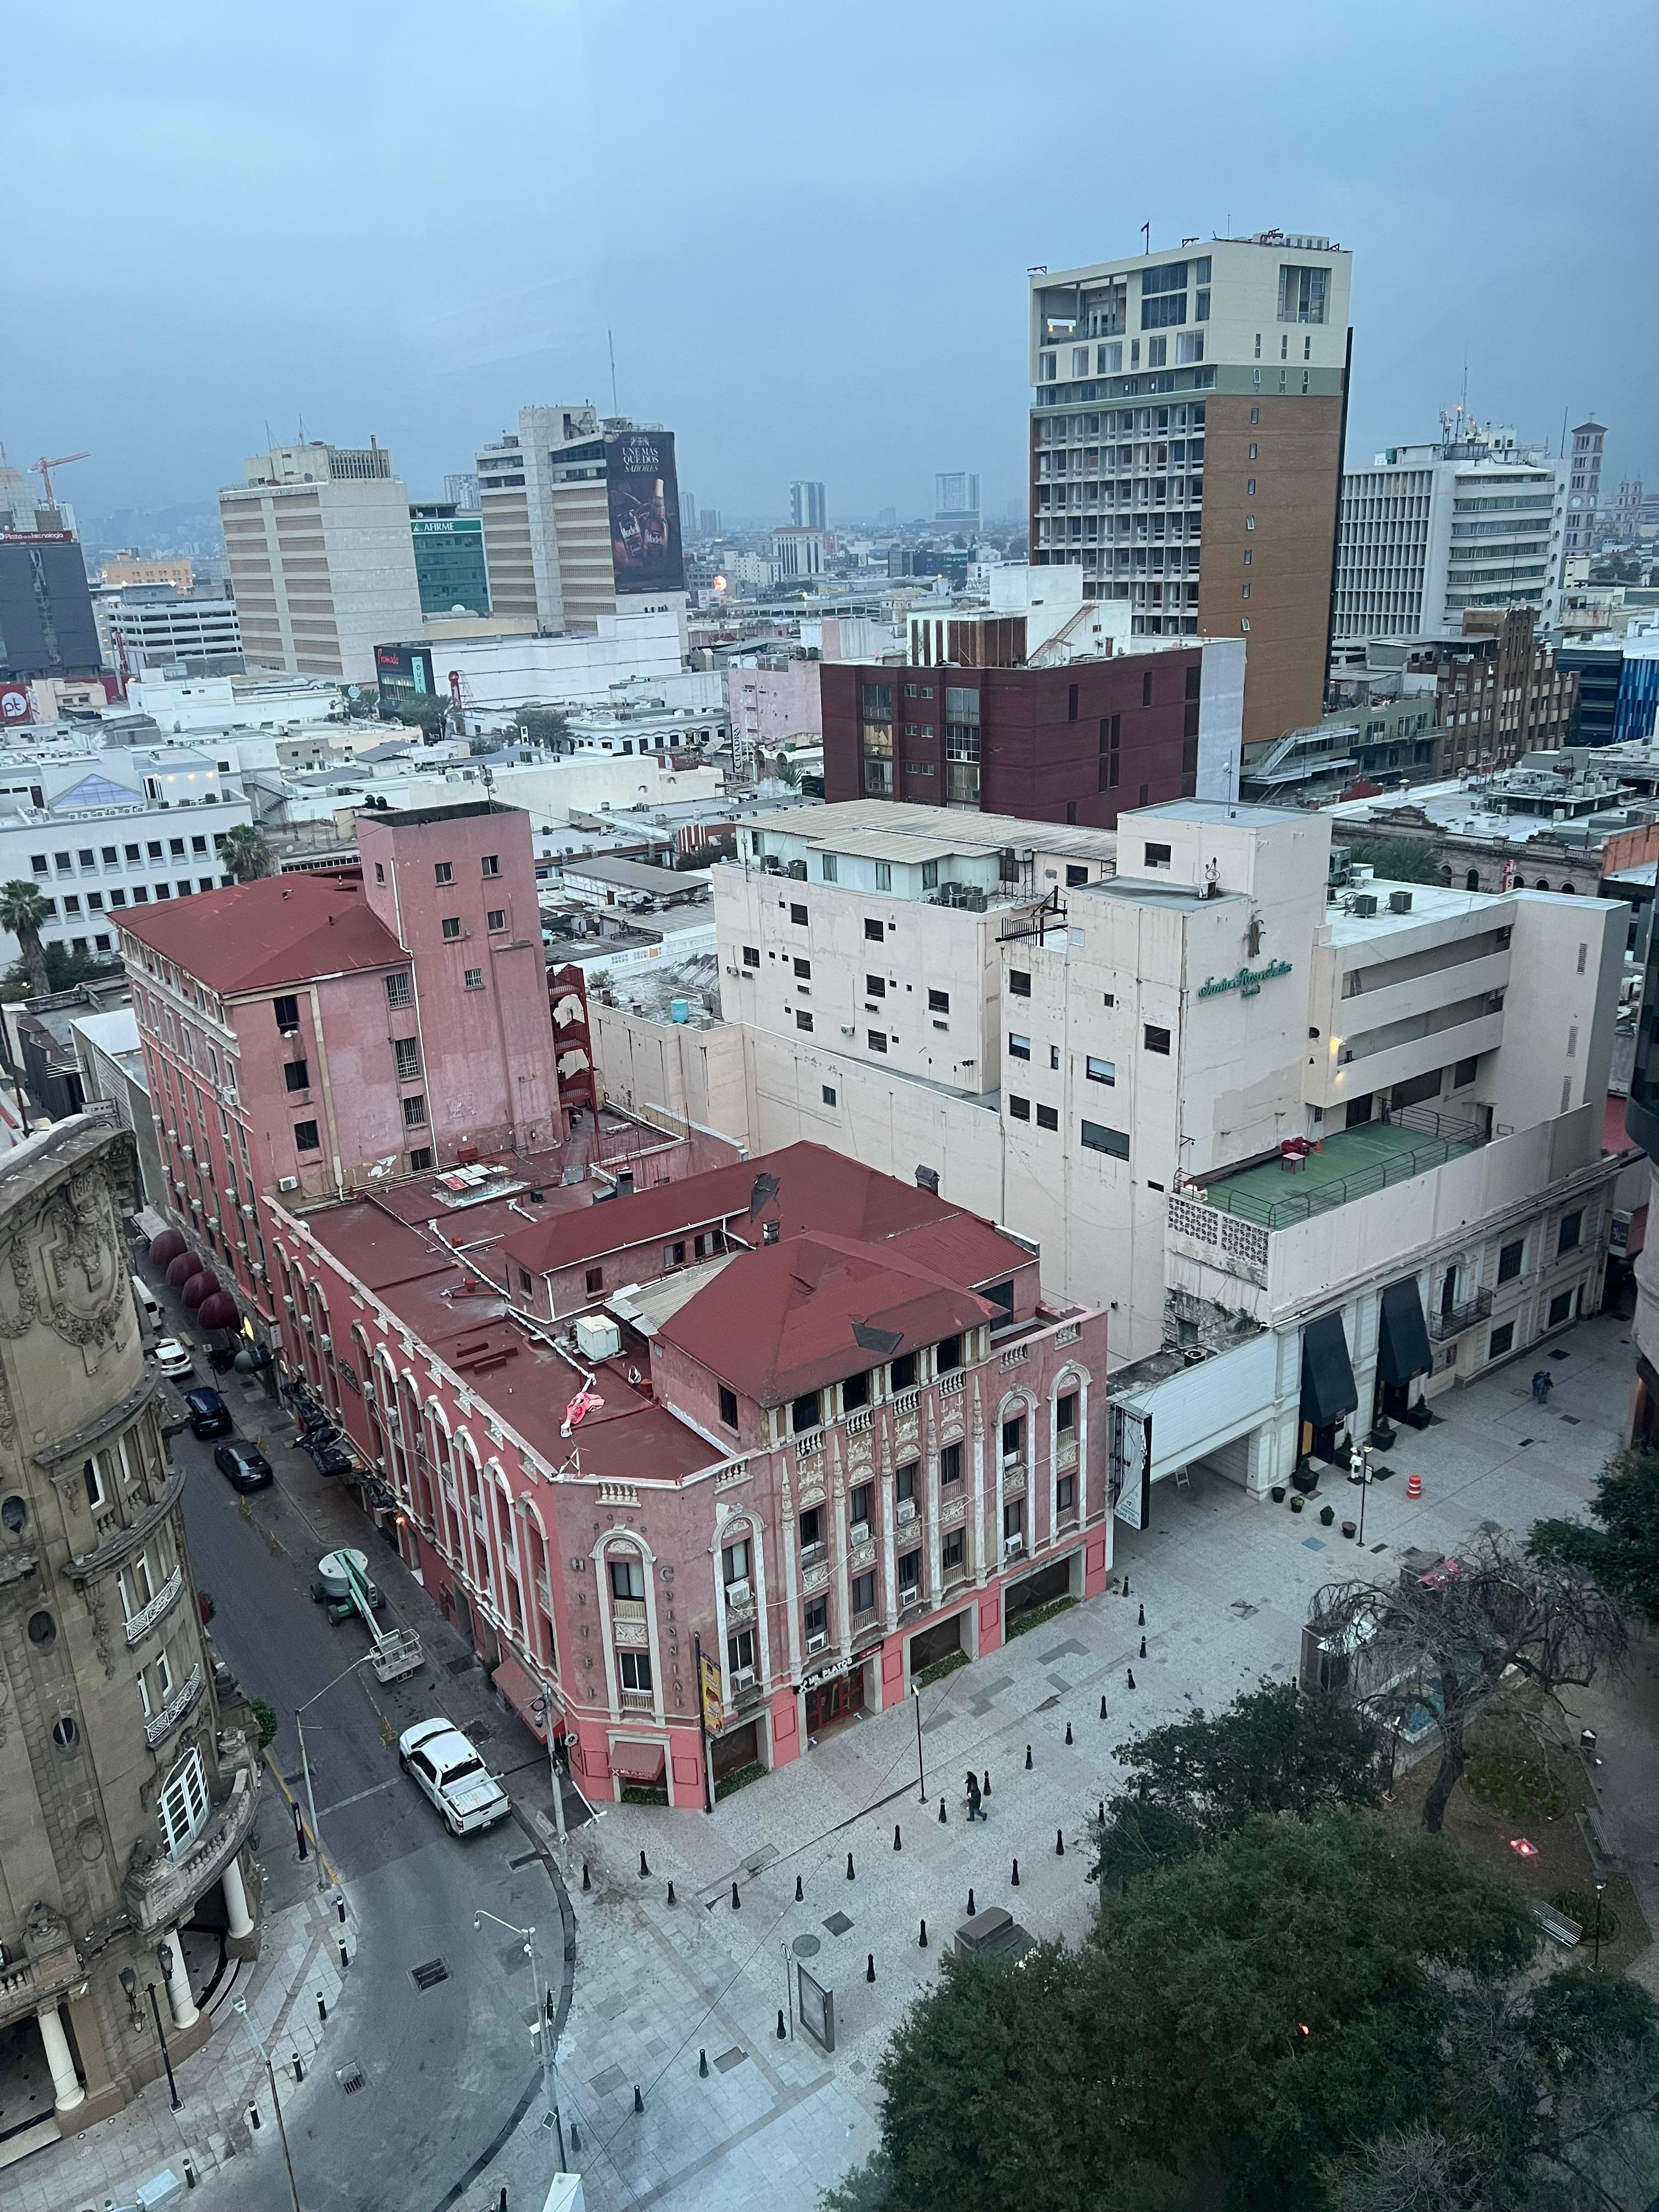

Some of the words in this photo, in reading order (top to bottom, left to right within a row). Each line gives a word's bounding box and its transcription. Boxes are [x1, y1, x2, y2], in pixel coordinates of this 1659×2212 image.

[623, 447, 640, 455] UNE
[623, 455, 641, 465] QUE
[642, 455, 659, 464] DOS
[624, 464, 659, 472] SABORES
[424, 522, 454, 532] AFIRME
[733, 727, 742, 769] CUADRA
[809, 1674, 821, 1685] MIL
[822, 1657, 853, 1679] PLATOS
